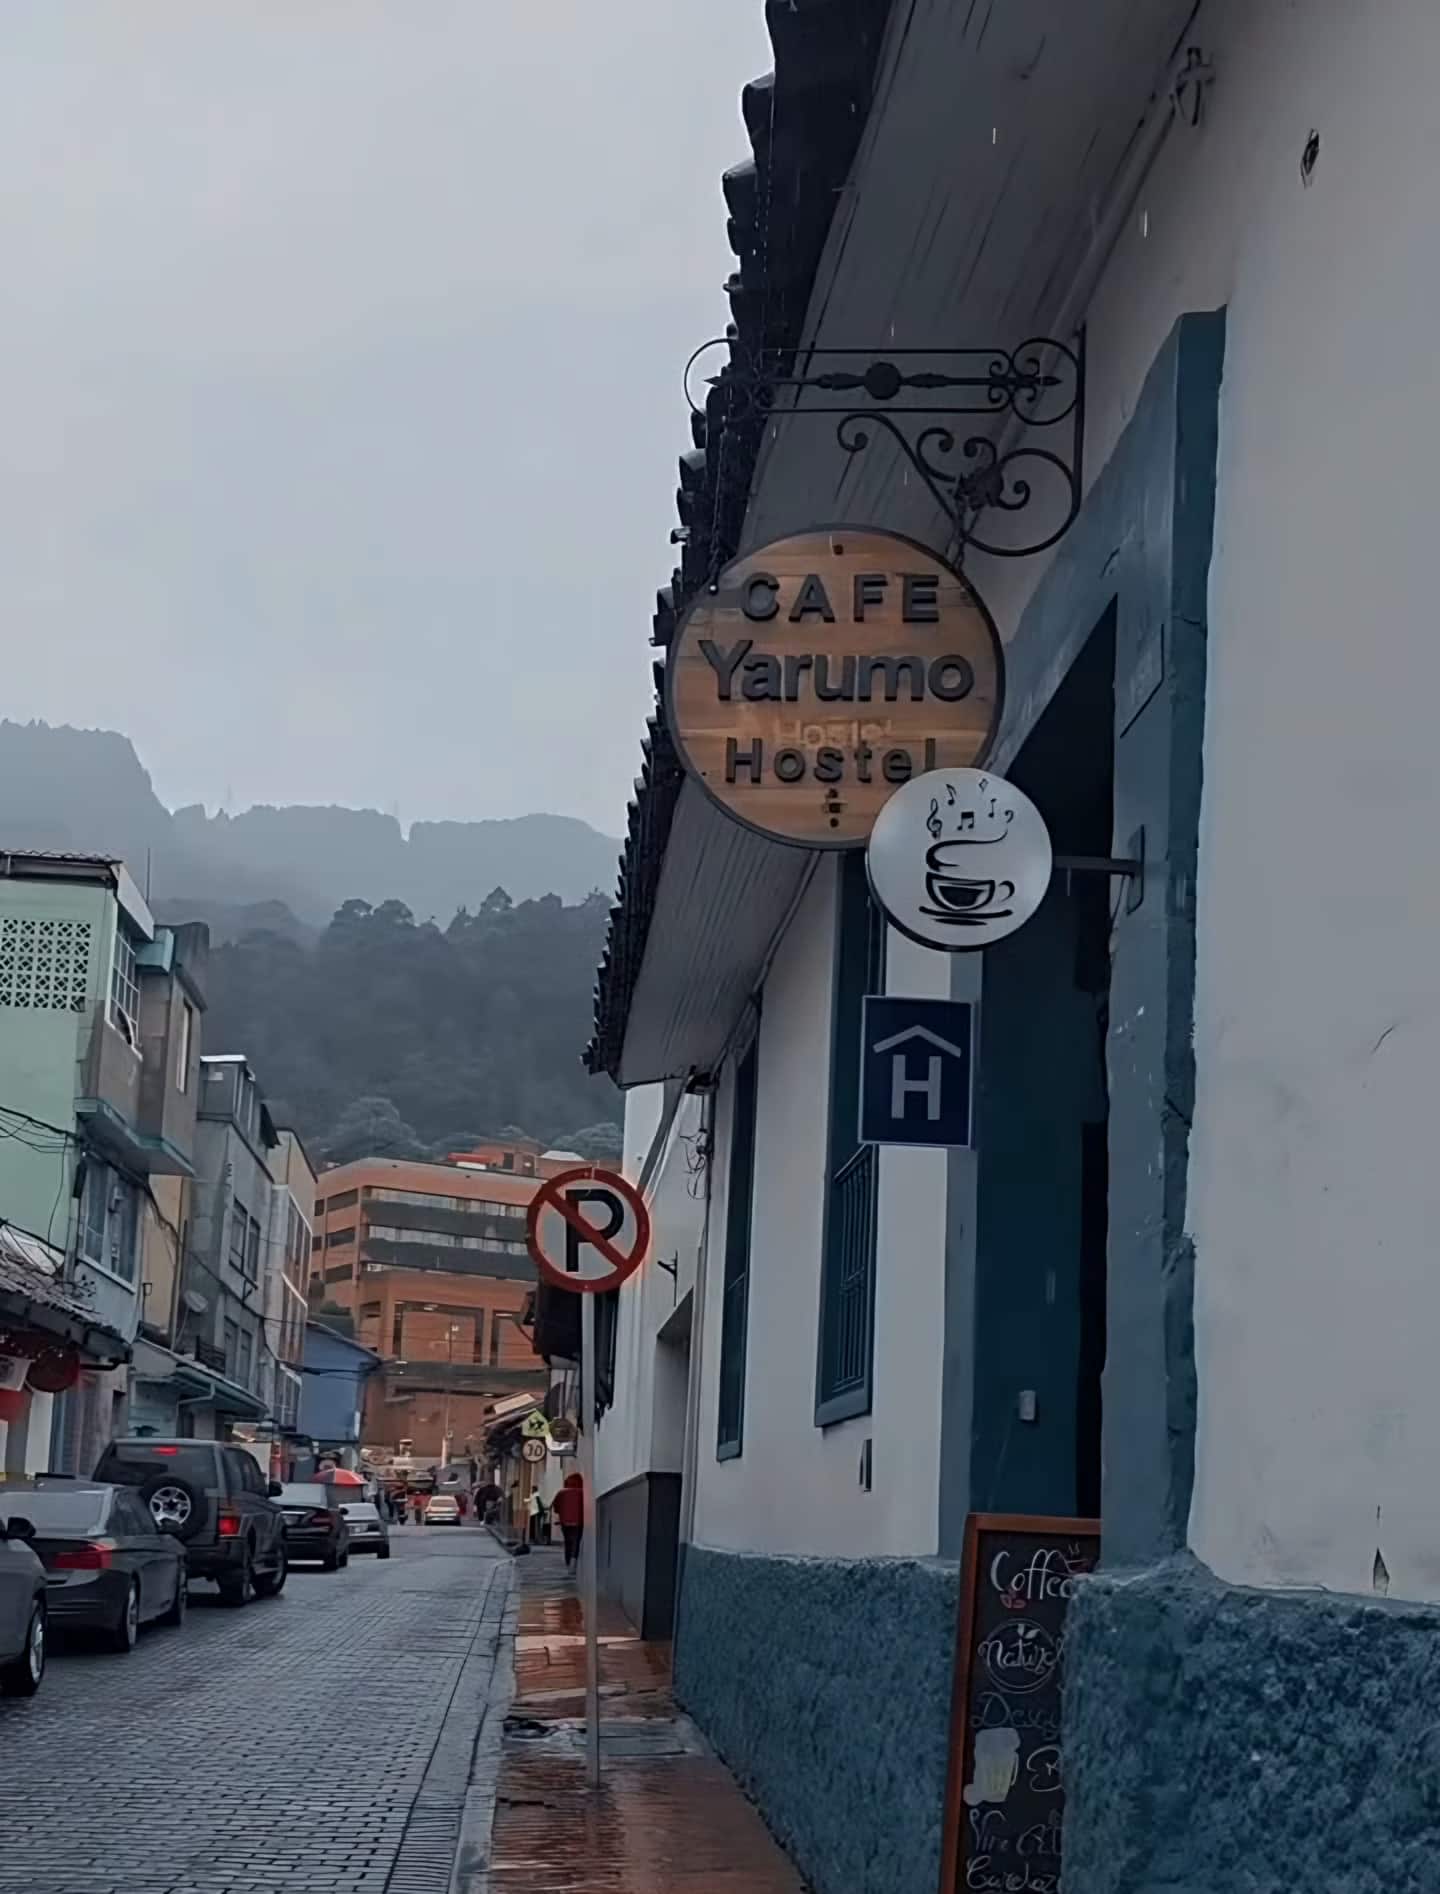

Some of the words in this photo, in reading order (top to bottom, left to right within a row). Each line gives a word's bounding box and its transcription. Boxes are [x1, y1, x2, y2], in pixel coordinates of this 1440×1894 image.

[740, 572, 940, 624] CAFE
[698, 639, 976, 702] Yarumo
[725, 737, 937, 784] Hostel
[891, 1055, 941, 1121] H
[565, 1189, 624, 1272] P
